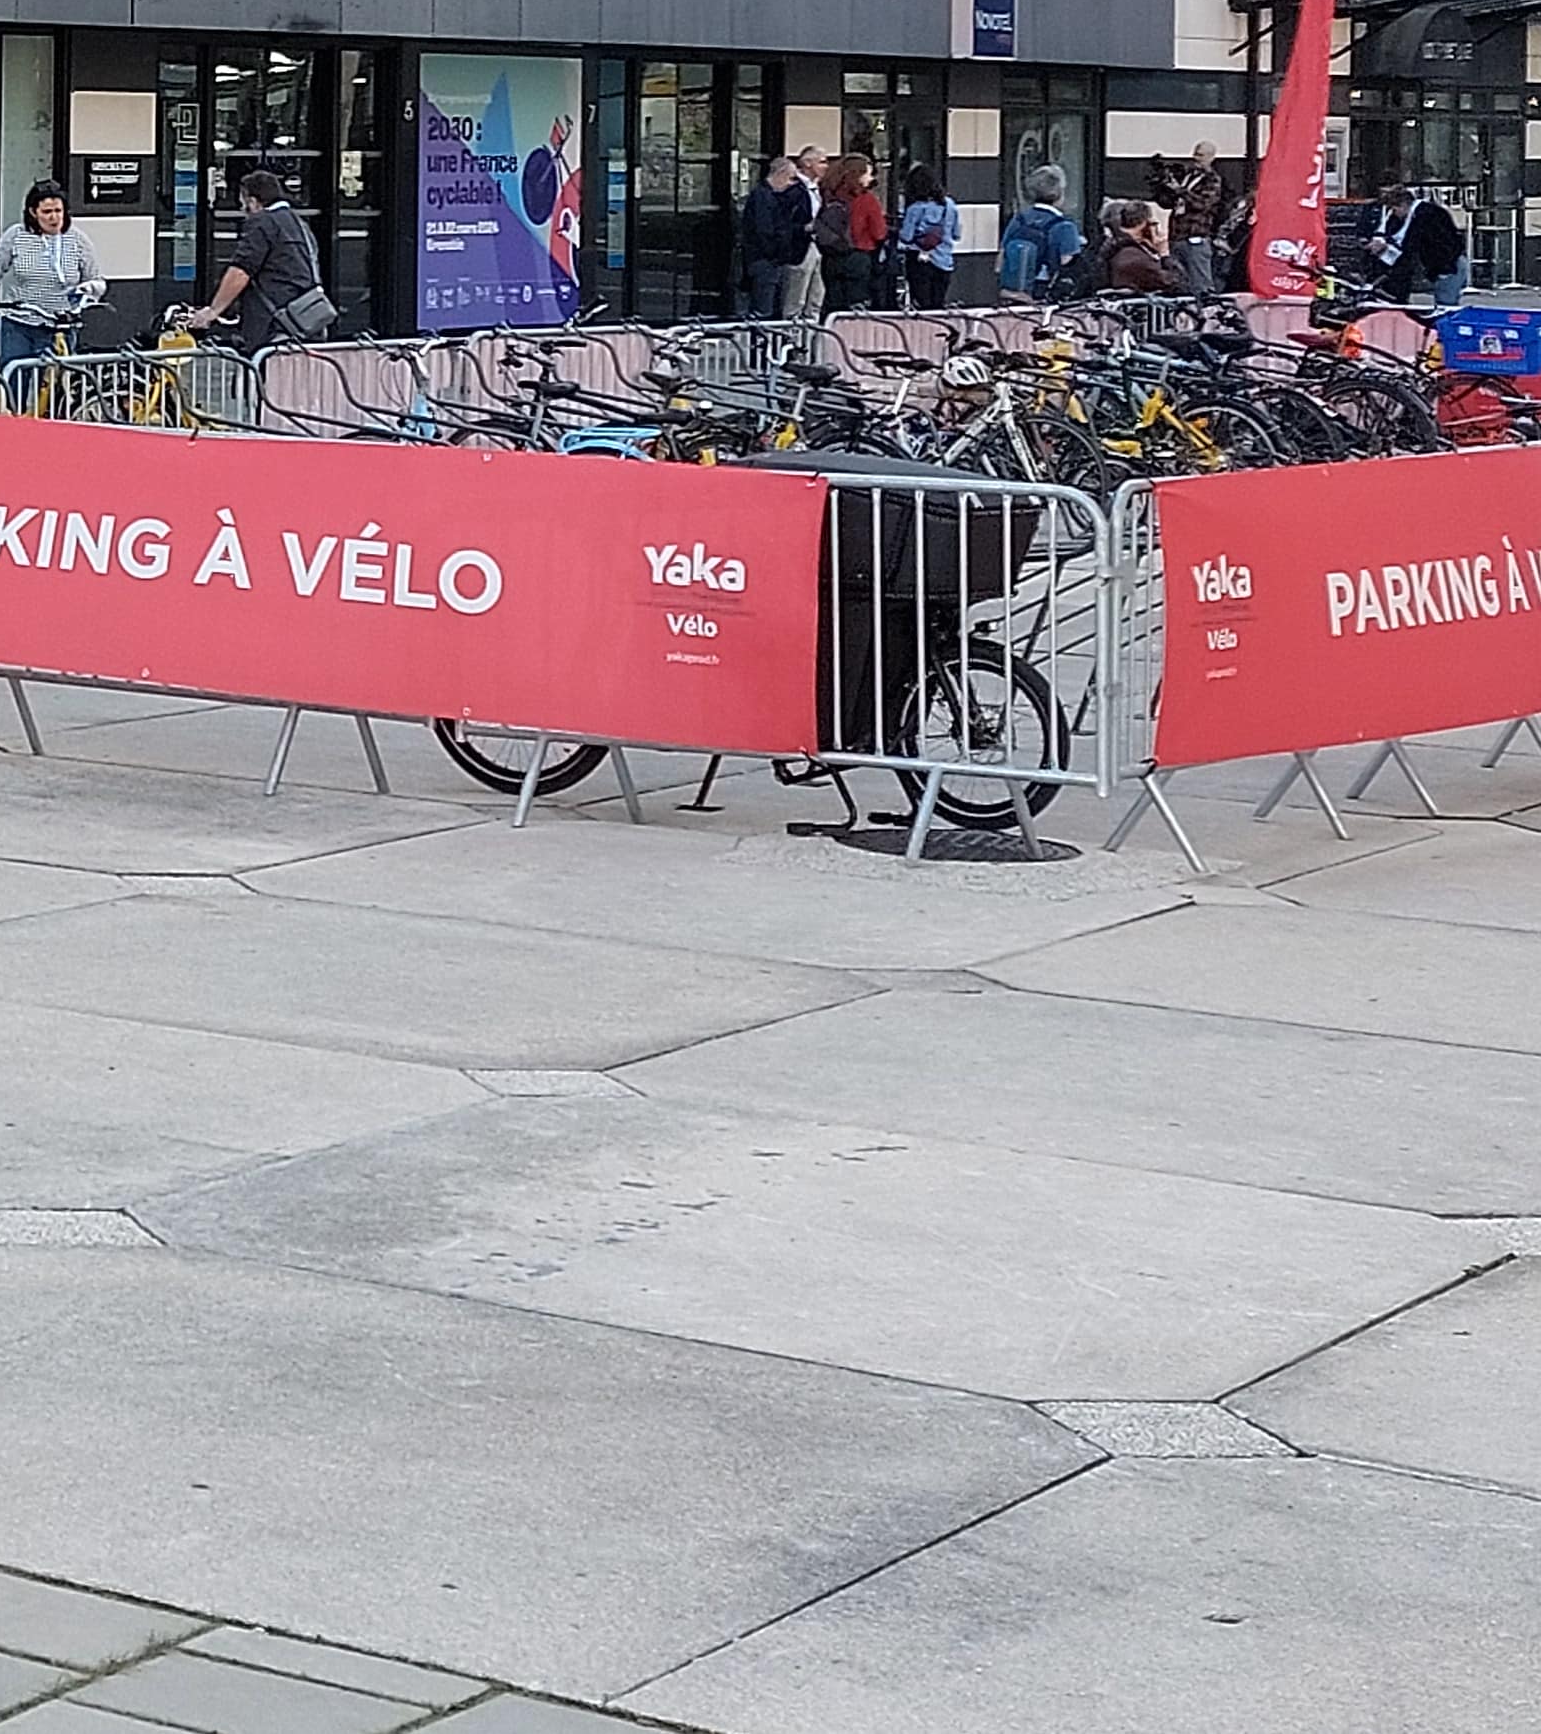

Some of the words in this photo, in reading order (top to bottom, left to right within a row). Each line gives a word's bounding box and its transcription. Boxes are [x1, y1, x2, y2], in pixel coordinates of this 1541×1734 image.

[428, 117, 473, 141] 2030
[427, 154, 457, 172] une
[460, 150, 517, 172] France
[426, 180, 493, 209] cyclable
[193, 507, 252, 589] À
[282, 521, 503, 614] VÉLO
[643, 542, 746, 591] Yaka
[1190, 554, 1253, 602] Yaka
[1326, 554, 1501, 637] PARKING
[1502, 535, 1532, 613] À
[666, 613, 718, 638] Vélo
[1207, 628, 1238, 650] Vélo
